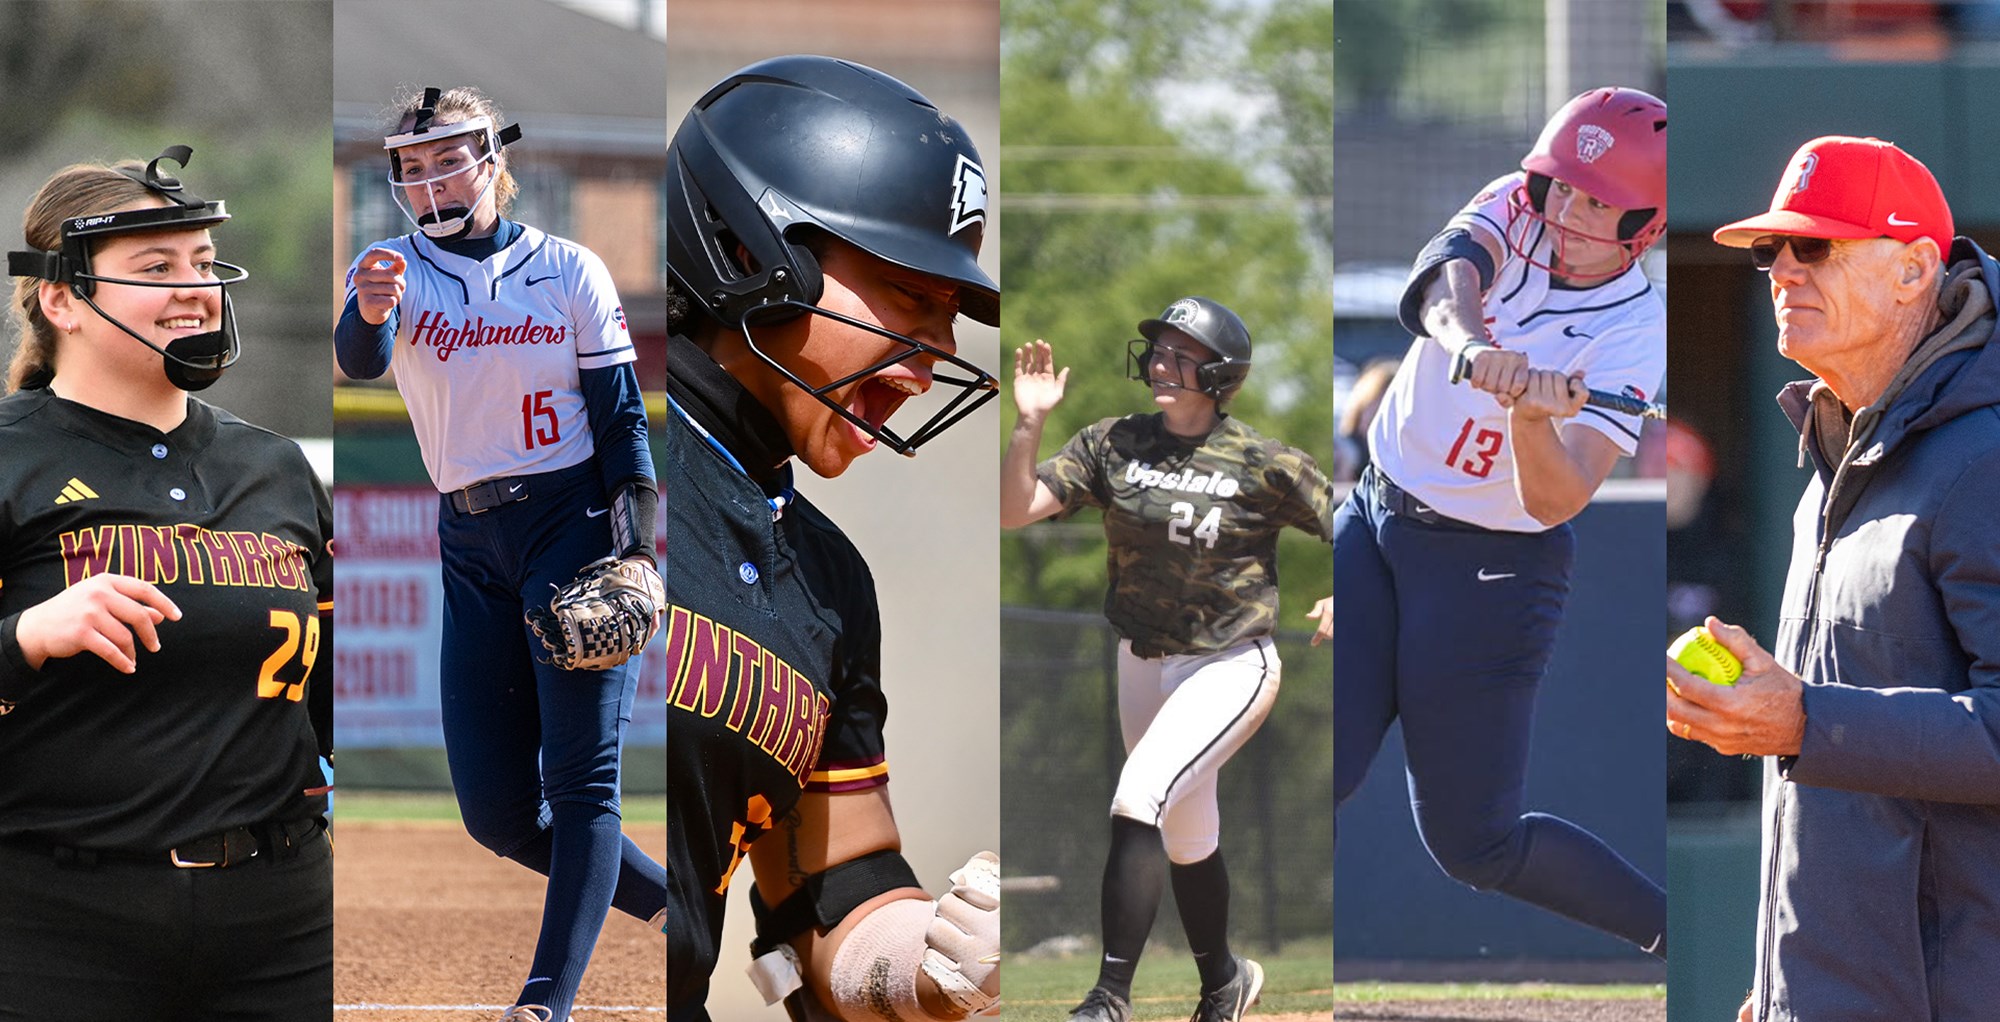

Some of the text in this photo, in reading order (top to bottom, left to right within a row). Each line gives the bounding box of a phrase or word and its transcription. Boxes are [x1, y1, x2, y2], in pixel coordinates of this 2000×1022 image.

[85, 215, 116, 227] RIP-IT
[410, 310, 567, 362] Highlanders
[521, 390, 561, 450] 15
[1445, 417, 1504, 479] 13
[1168, 501, 1223, 550] 24
[256, 609, 321, 703] 29
